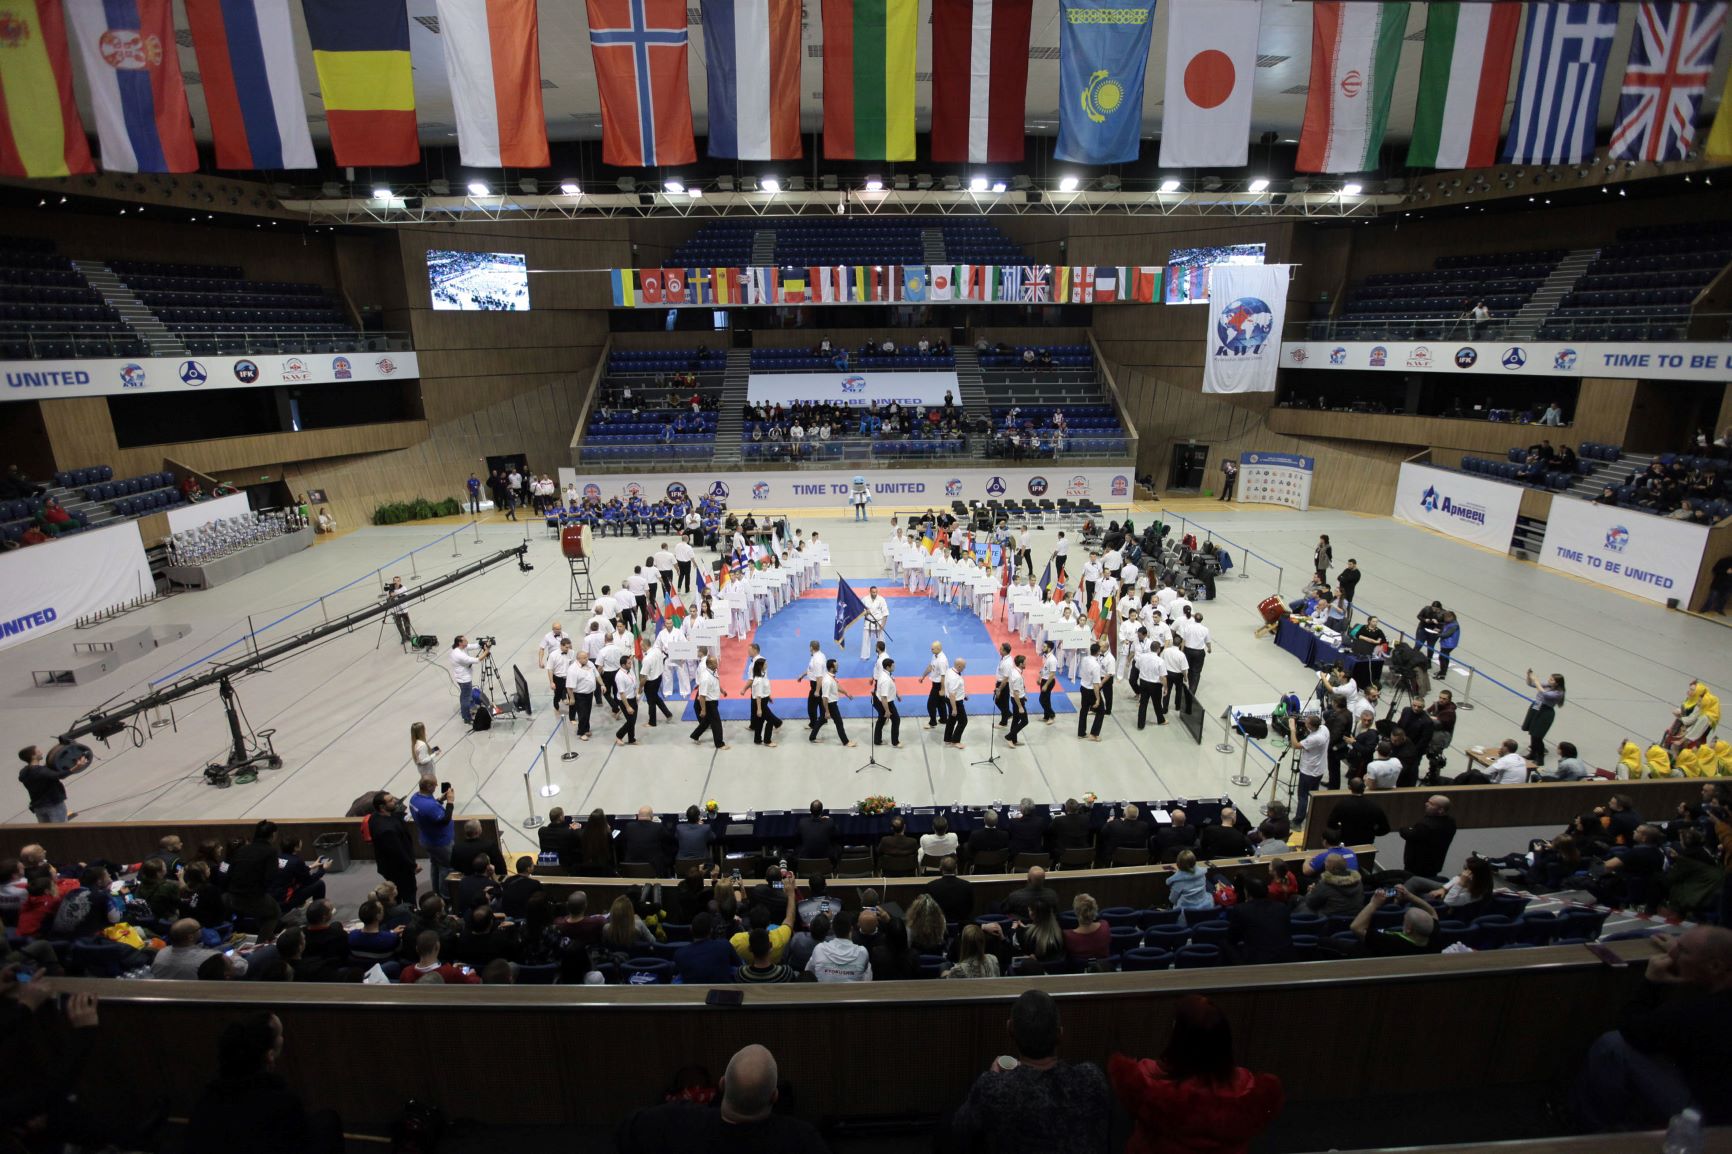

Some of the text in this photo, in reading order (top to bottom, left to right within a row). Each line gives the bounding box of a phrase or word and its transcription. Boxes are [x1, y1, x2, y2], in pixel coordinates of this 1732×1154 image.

[1603, 353, 1651, 367] TIME
[1658, 354, 1684, 368] TO
[1689, 355, 1718, 369] BE
[6, 371, 90, 388] UNITED
[239, 371, 256, 379] IFK
[792, 484, 826, 495] TIME
[830, 484, 849, 494] TO
[875, 482, 926, 494] UNITED
[1557, 546, 1675, 590] TIME TO BE UNITED
[101, 664, 106, 672] 2
